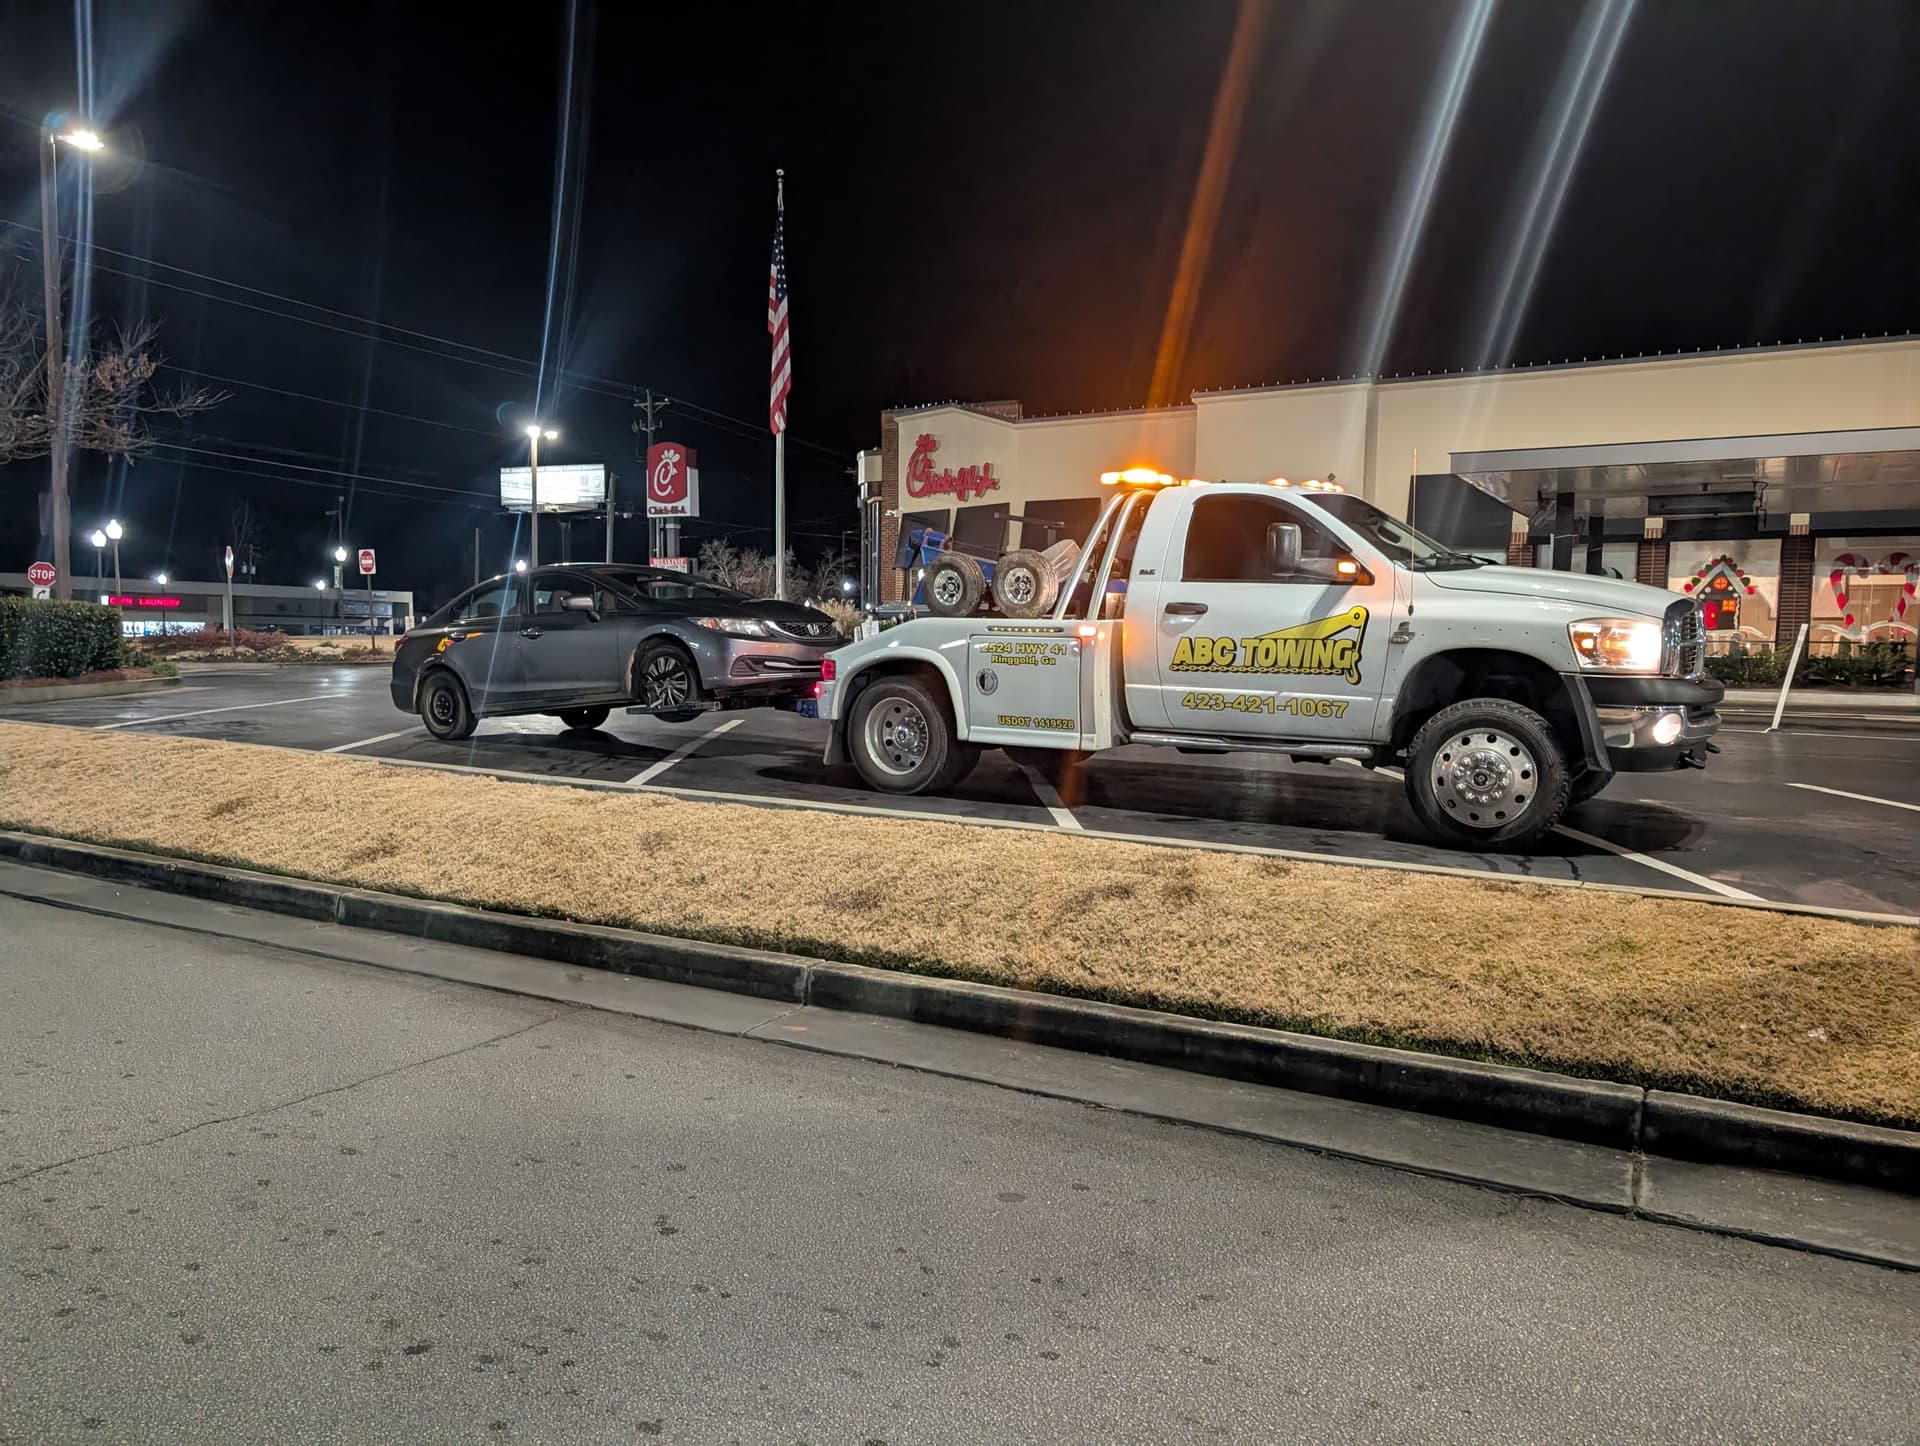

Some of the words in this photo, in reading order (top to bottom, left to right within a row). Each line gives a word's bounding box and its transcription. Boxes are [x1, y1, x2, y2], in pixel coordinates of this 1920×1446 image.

[30, 569, 55, 580] STOP
[109, 595, 133, 606] CIN
[1015, 643, 1047, 655] HWY
[1050, 645, 1068, 656] 41
[1174, 637, 1236, 666] ABC
[1240, 638, 1357, 669] TOWING
[991, 655, 1039, 666] Ringgold,
[1041, 656, 1056, 665] Ga
[1181, 692, 1349, 719] 423-421-1067
[997, 715, 1031, 727] USDOT
[1034, 717, 1074, 729] 1419528
